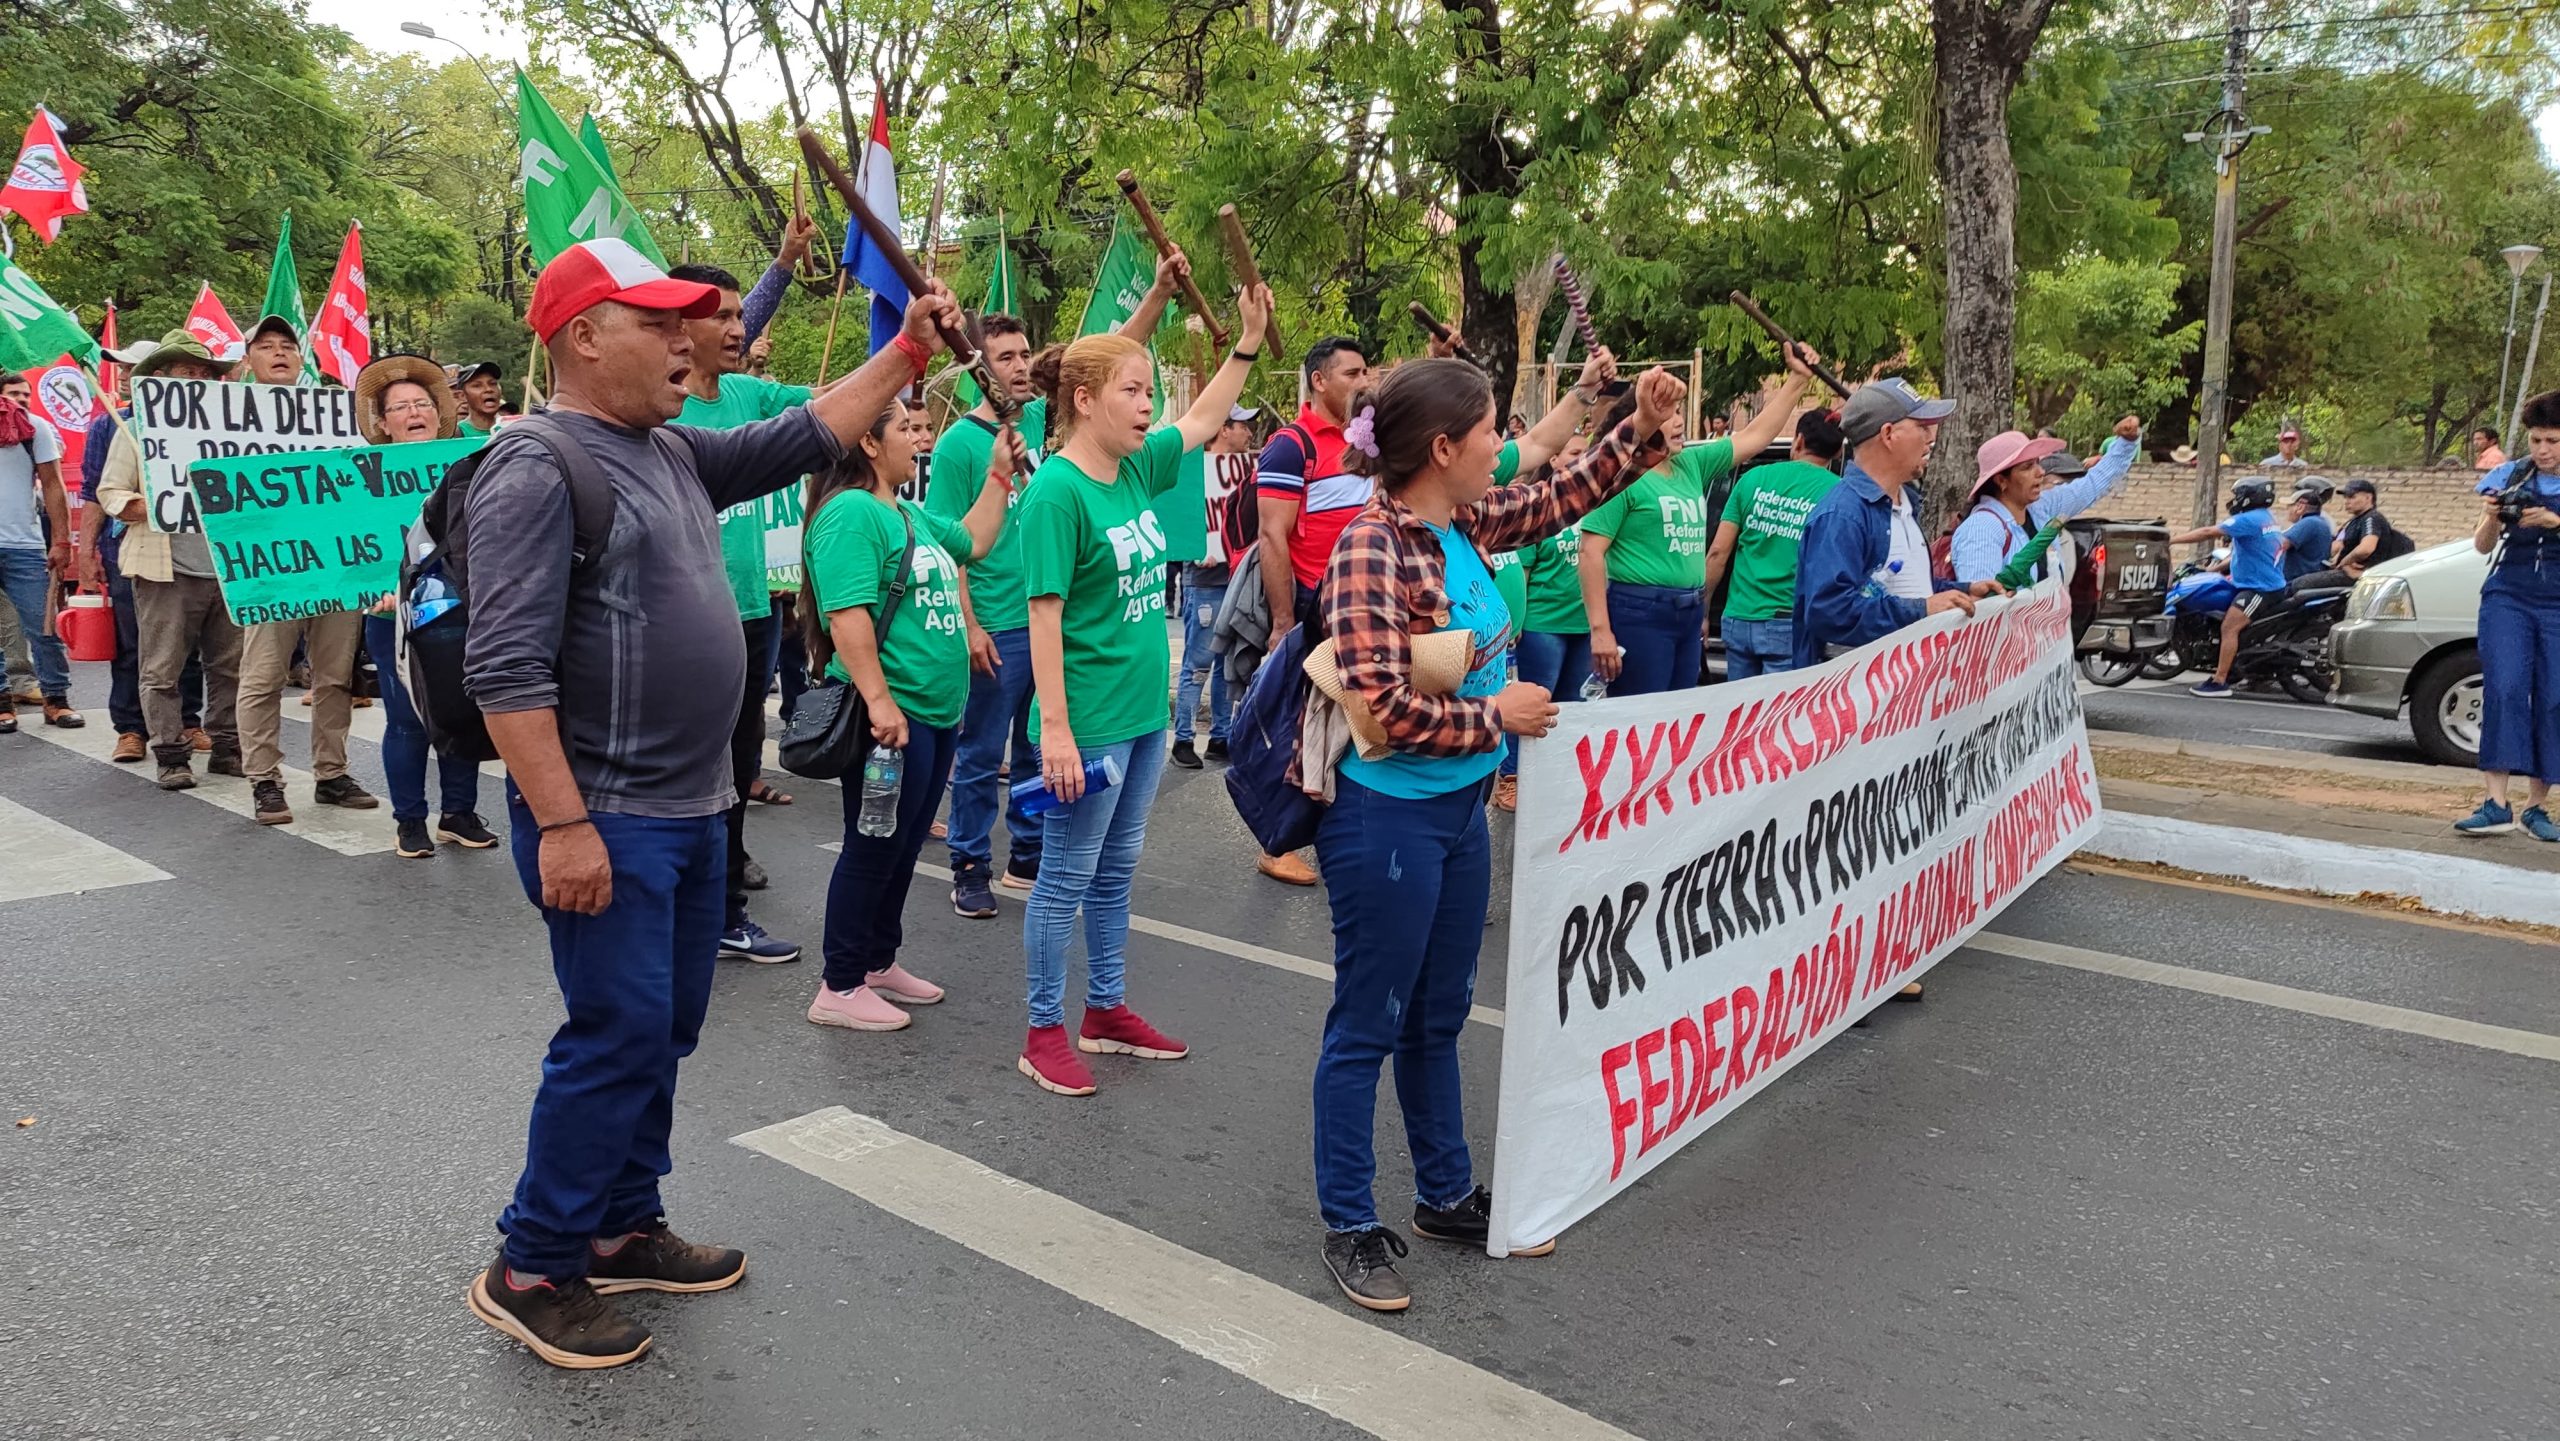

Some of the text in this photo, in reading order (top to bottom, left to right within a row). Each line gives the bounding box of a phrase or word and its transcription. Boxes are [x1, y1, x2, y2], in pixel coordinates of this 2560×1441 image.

[138, 378, 210, 430] POR
[222, 384, 263, 432] LA
[142, 438, 170, 461] DE
[190, 464, 342, 514] BASTA
[1753, 501, 1808, 526] Nacional
[214, 539, 324, 583] HACIA
[336, 534, 383, 567] LAS
[2118, 565, 2159, 591] ISUZU
[236, 598, 345, 625] FEDERACION
[1558, 713, 1706, 854] XXX
[1688, 661, 1860, 806] MARCHA
[1558, 881, 1649, 1028] POR
[1655, 817, 1786, 973] TIERRA
[1601, 903, 1864, 1184] FEDERACIÓN
[1862, 832, 1979, 1001] NACIONAL
